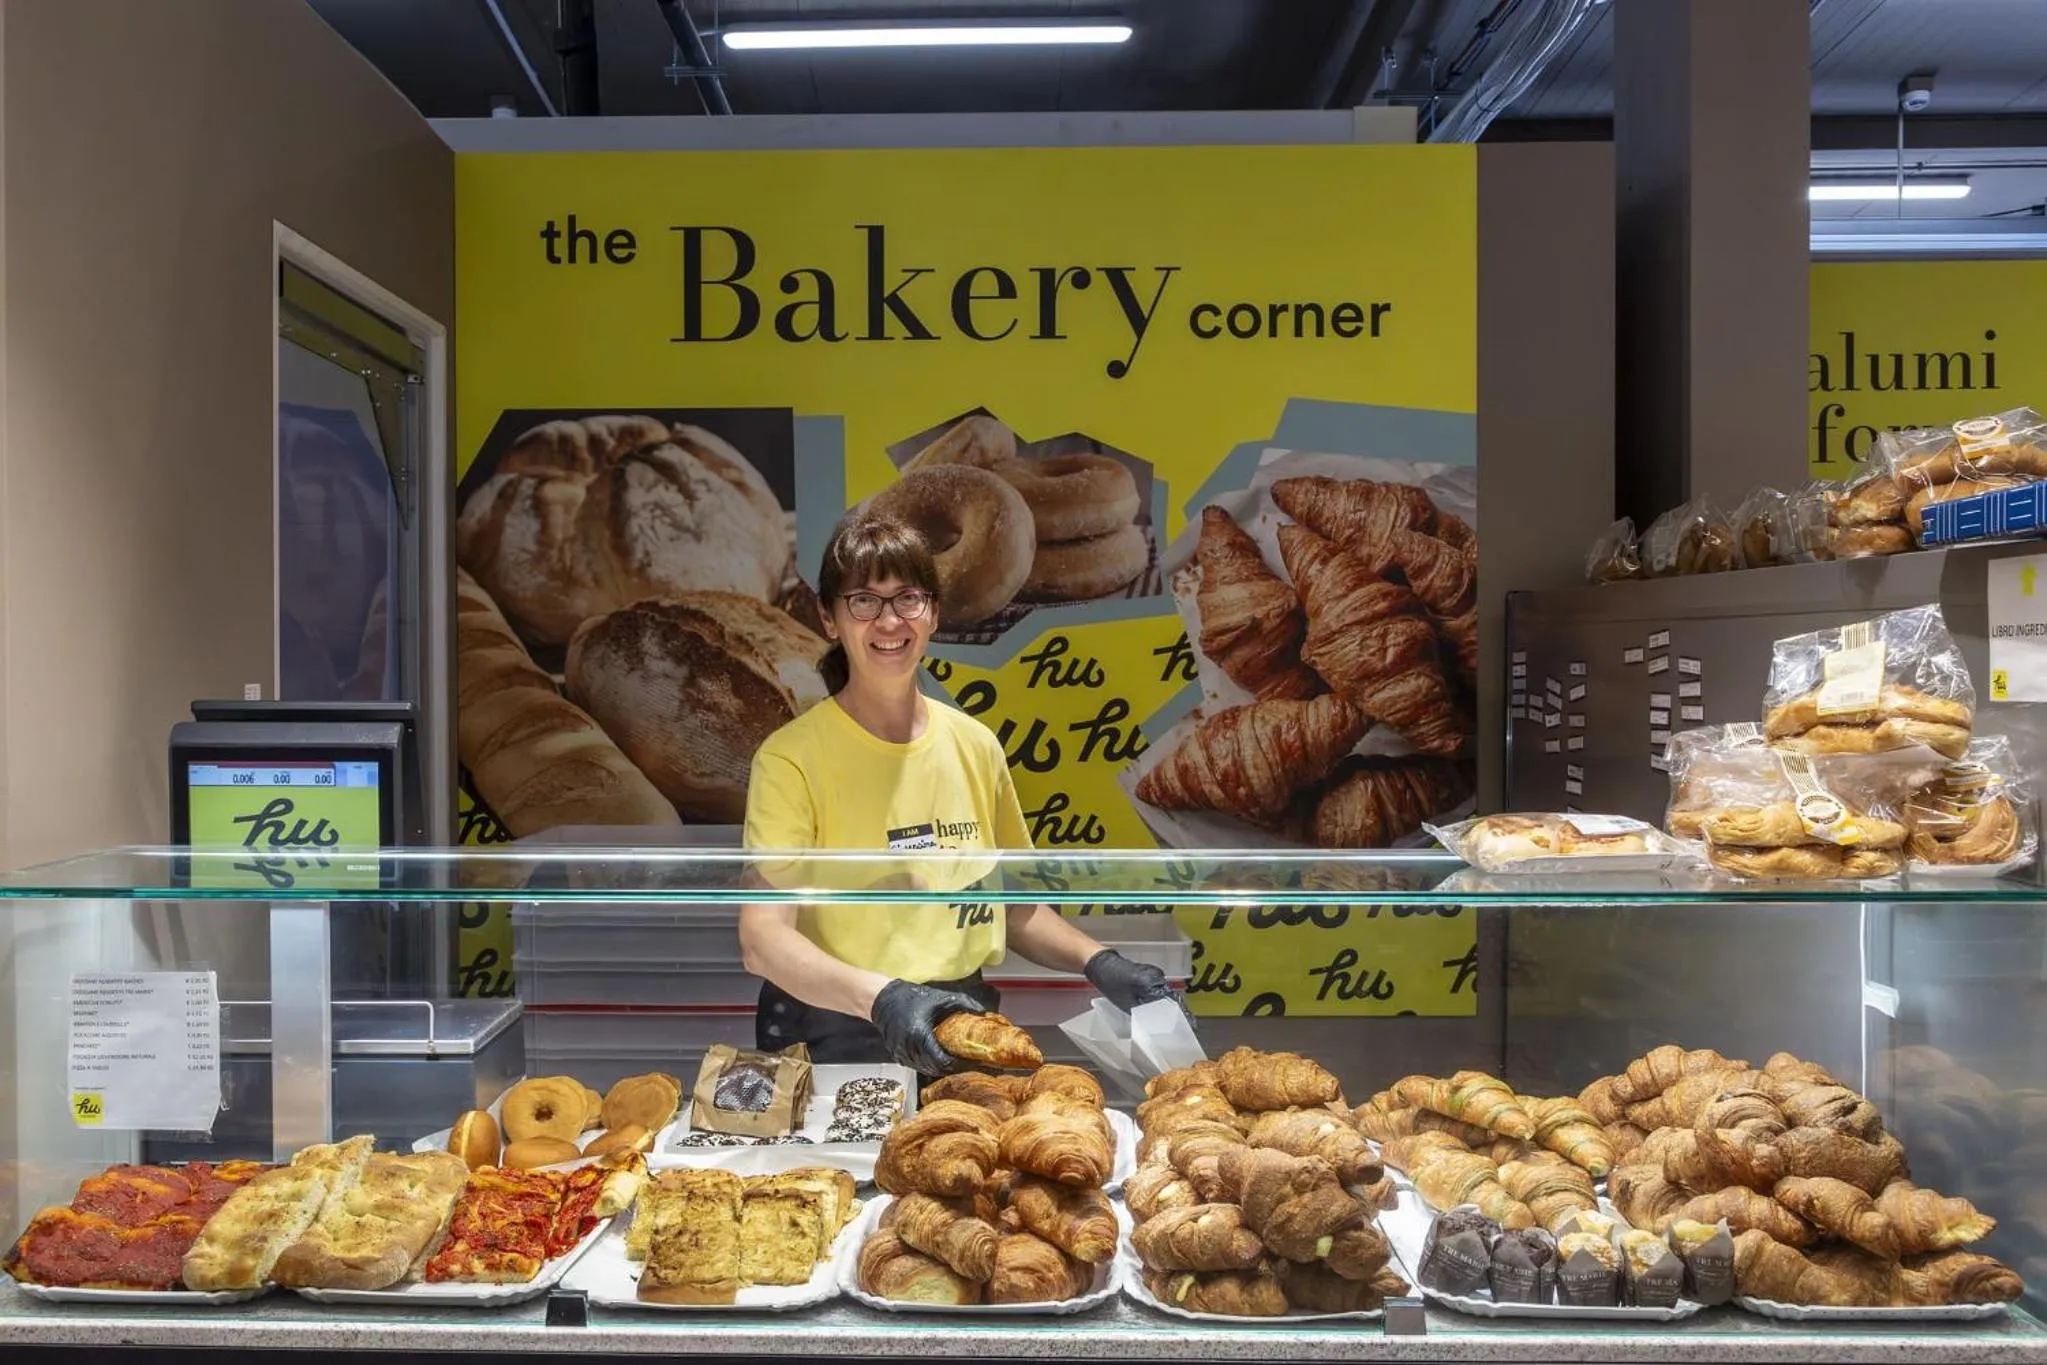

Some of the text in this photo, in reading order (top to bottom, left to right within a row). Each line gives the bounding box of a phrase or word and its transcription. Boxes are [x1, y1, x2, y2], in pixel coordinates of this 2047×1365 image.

[540, 214, 1391, 380] the Bakery corner
[1019, 636, 1105, 689] hu
[1153, 631, 1199, 682] h
[233, 798, 339, 846] hu
[936, 819, 980, 840] happy
[1308, 948, 1395, 1000] hu
